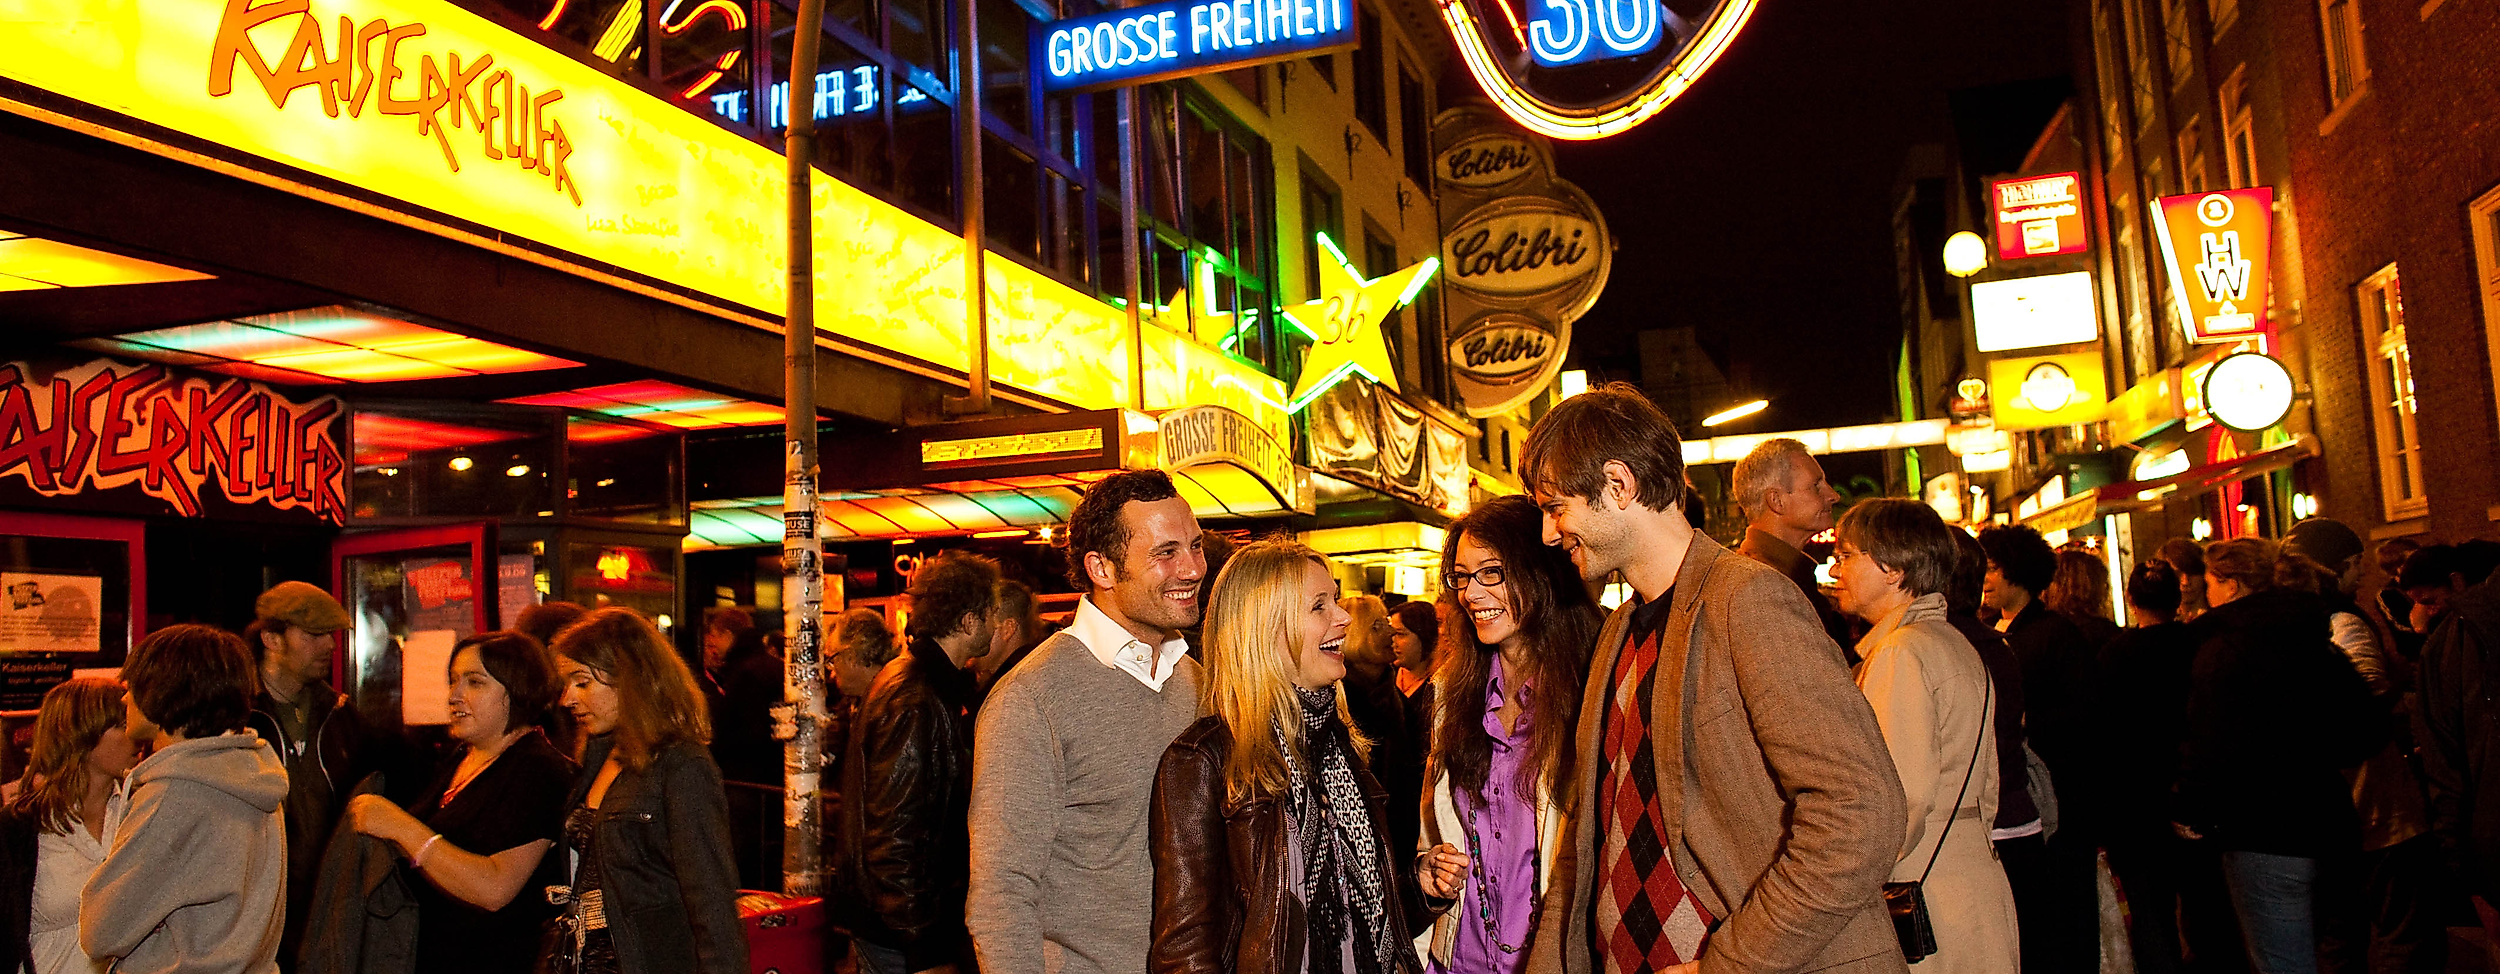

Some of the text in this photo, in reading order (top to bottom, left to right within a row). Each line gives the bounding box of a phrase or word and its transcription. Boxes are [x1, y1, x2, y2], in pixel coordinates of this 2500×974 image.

[1048, 10, 1179, 77] GROSSE
[208, 0, 582, 207] KAISERKELLER
[1448, 145, 1533, 180] Colibri
[1451, 228, 1590, 279] Colibri
[1322, 292, 1365, 345] 36
[1463, 336, 1547, 368] Colibri
[1164, 411, 1217, 466] GROSSE
[1221, 412, 1271, 476] FREIHEIT
[1276, 453, 1290, 496] 36
